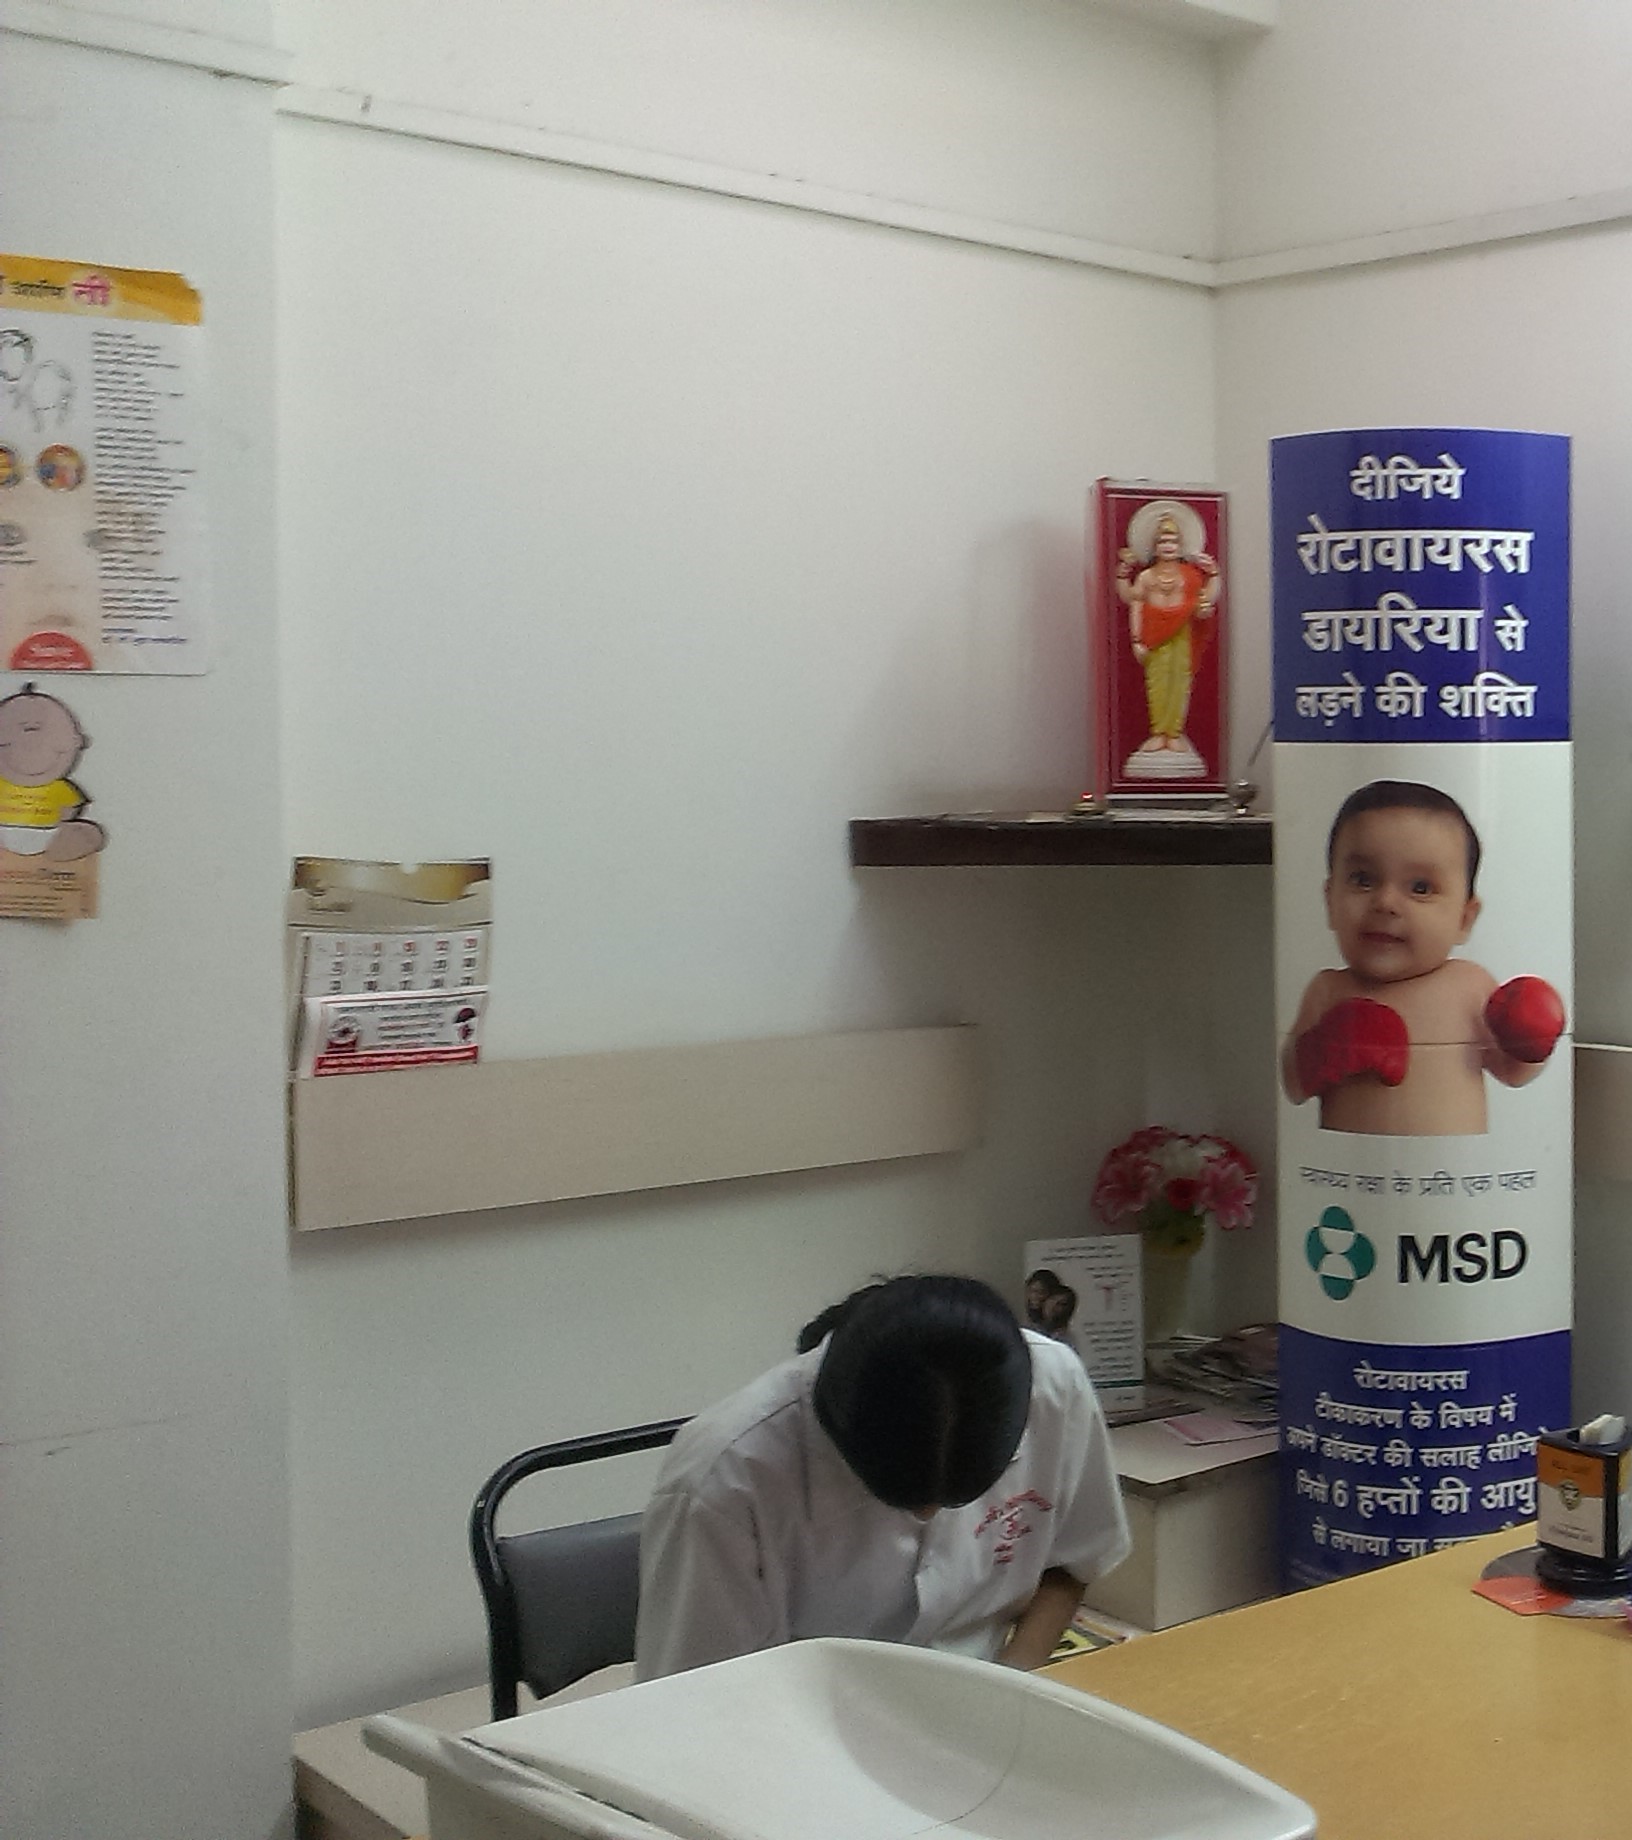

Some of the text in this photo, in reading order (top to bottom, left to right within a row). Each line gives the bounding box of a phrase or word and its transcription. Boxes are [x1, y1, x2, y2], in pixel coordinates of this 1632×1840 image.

[1350, 453, 1466, 500] दीजिये
[1296, 513, 1535, 575] रोटावायरस
[1301, 592, 1529, 652] डायरिया से
[1295, 671, 1538, 727] लड़ने की शक्ति
[1391, 1169, 1413, 1193] के
[1419, 1170, 1454, 1196] प्रति
[1461, 1174, 1493, 1197] एक
[1497, 1170, 1538, 1192] पहल
[1397, 1230, 1528, 1284] MSD
[1353, 1360, 1470, 1391] रोटावायरस
[1314, 1391, 1518, 1430] टीकाकरण के विषय में
[1320, 1433, 1378, 1466] डॉक्टर
[1383, 1438, 1414, 1468] की
[1418, 1444, 1483, 1470] सलाह
[1486, 1426, 1550, 1462] लीजि
[1332, 1480, 1349, 1508] 6
[1430, 1476, 1473, 1515] की
[1329, 1529, 1391, 1558] लगाया
[1395, 1538, 1430, 1557] जा
